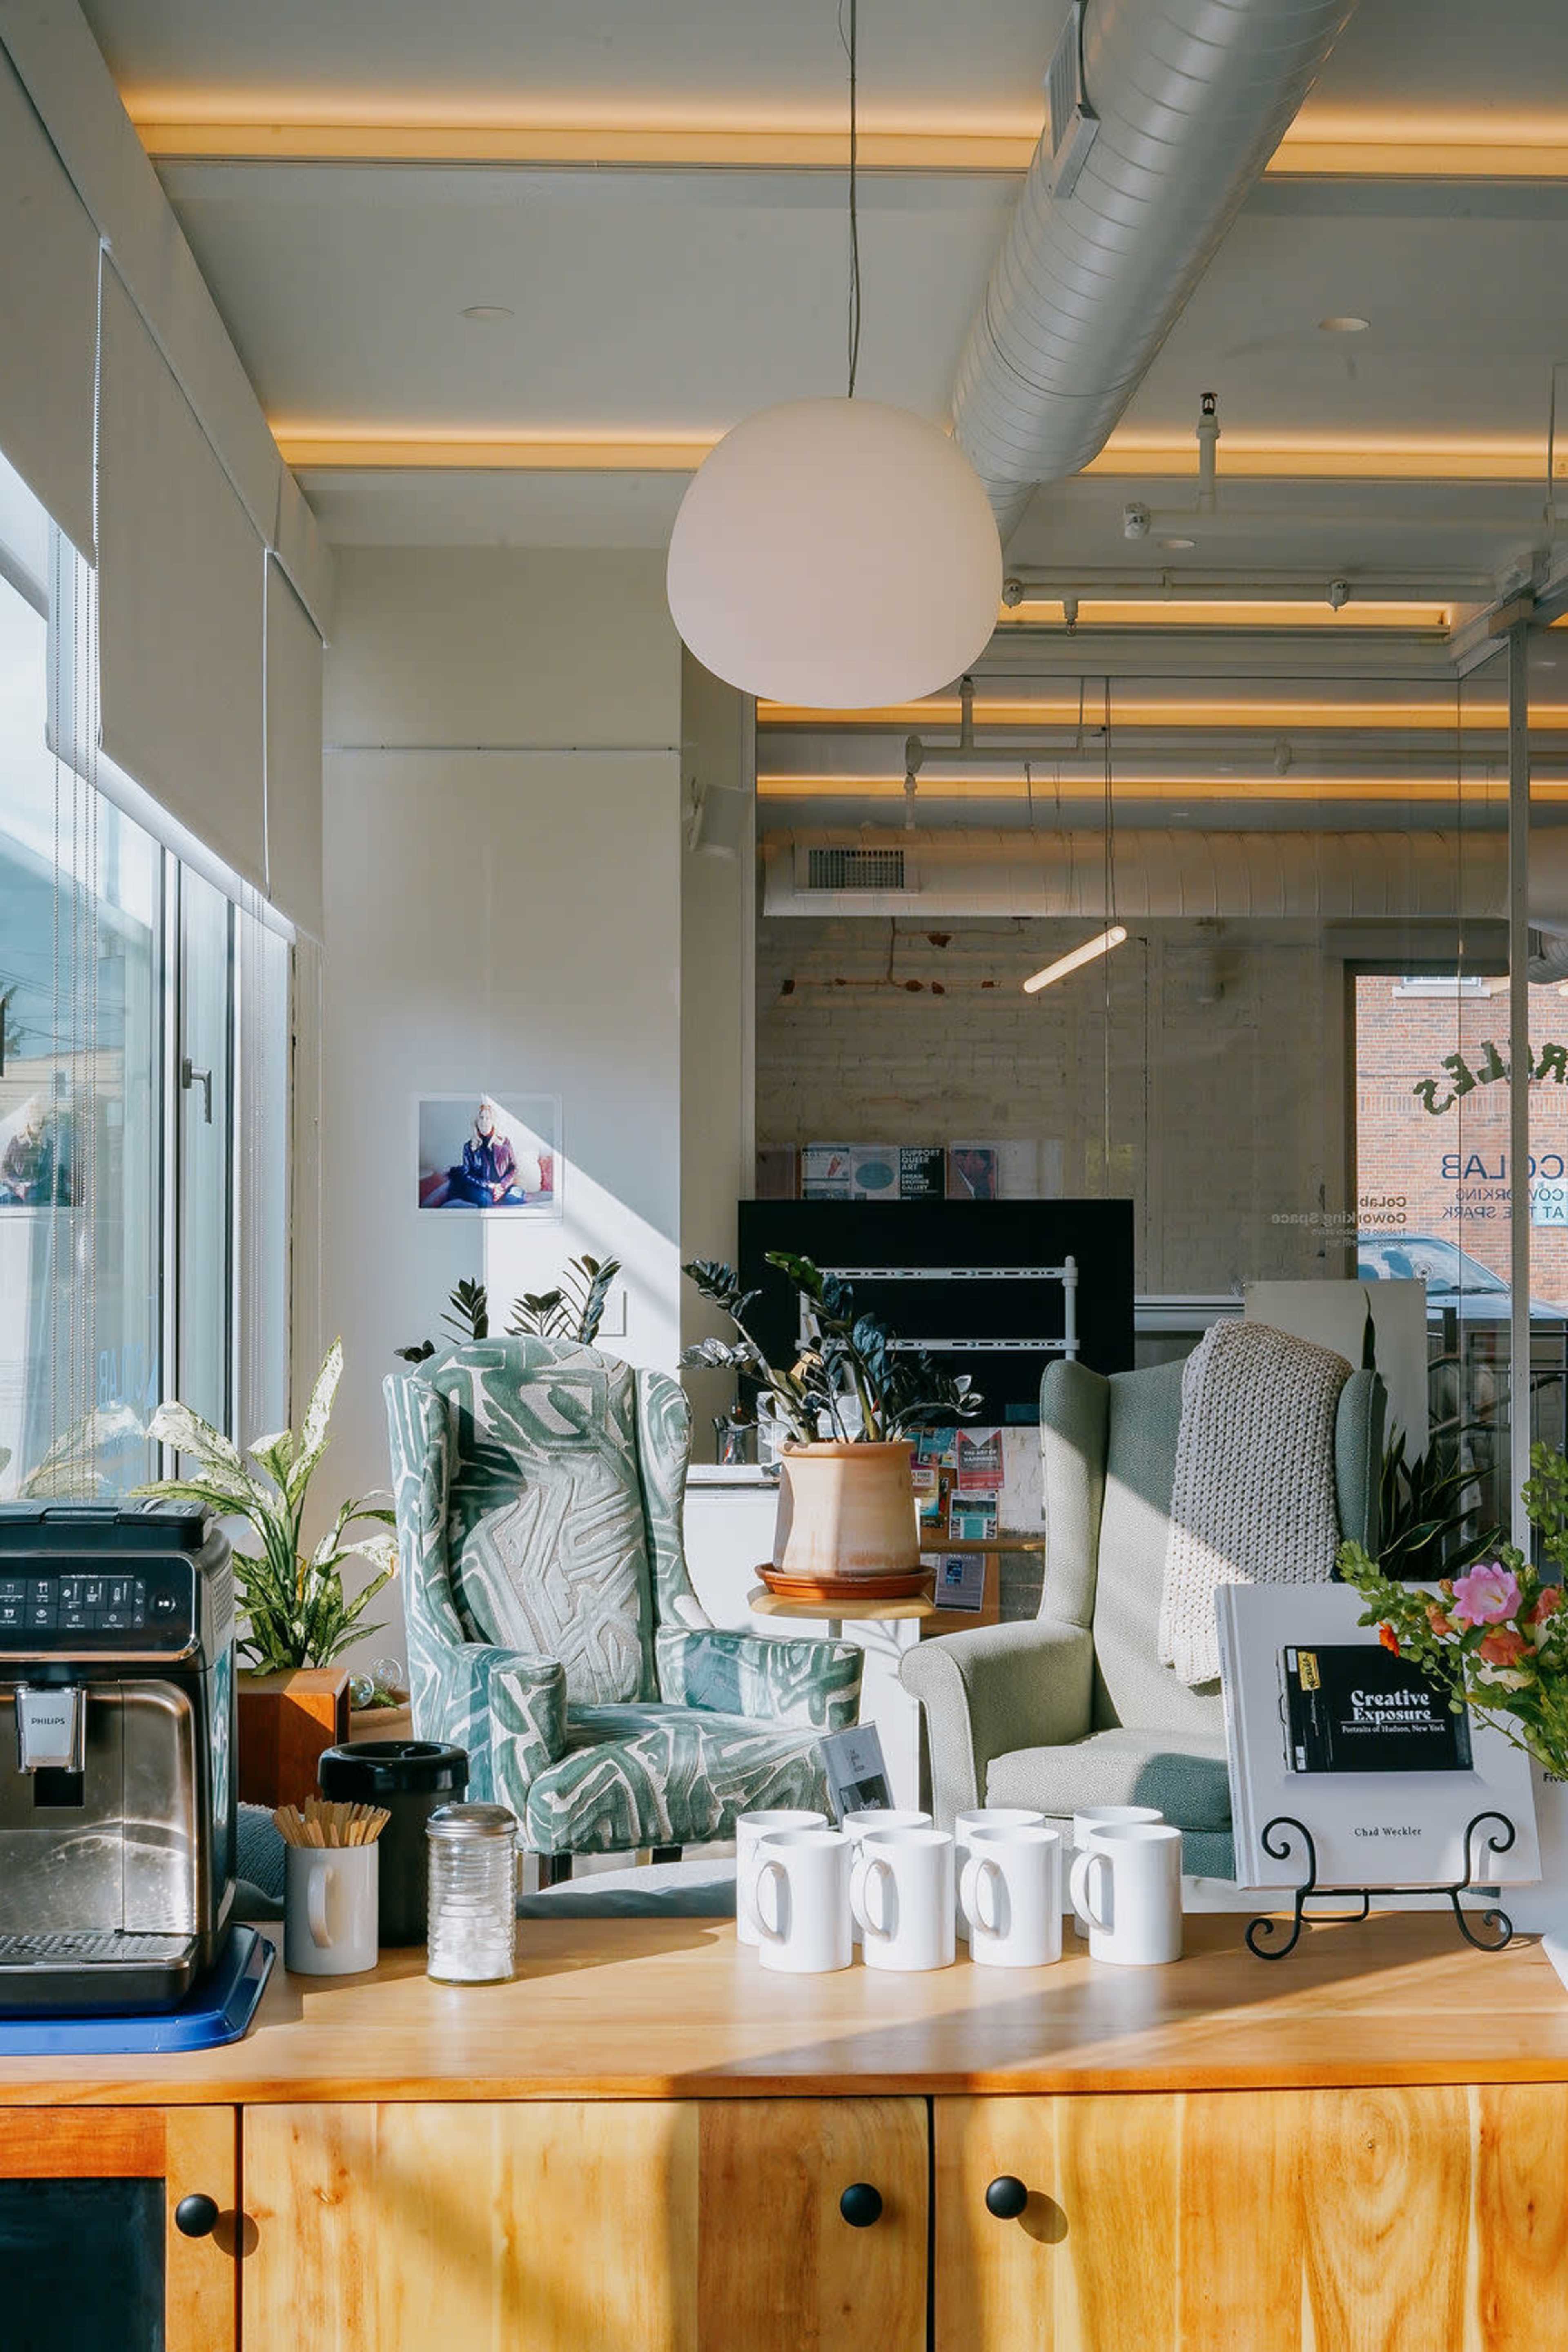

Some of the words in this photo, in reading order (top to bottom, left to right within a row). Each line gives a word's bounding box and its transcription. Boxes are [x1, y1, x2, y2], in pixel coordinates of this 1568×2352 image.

[1351, 1689, 1430, 1706] Creative
[1353, 1707, 1432, 1725] Exposure
[1429, 1724, 1446, 1732] York
[1354, 1827, 1379, 1837] Chad
[1382, 1826, 1422, 1836] Weckler
